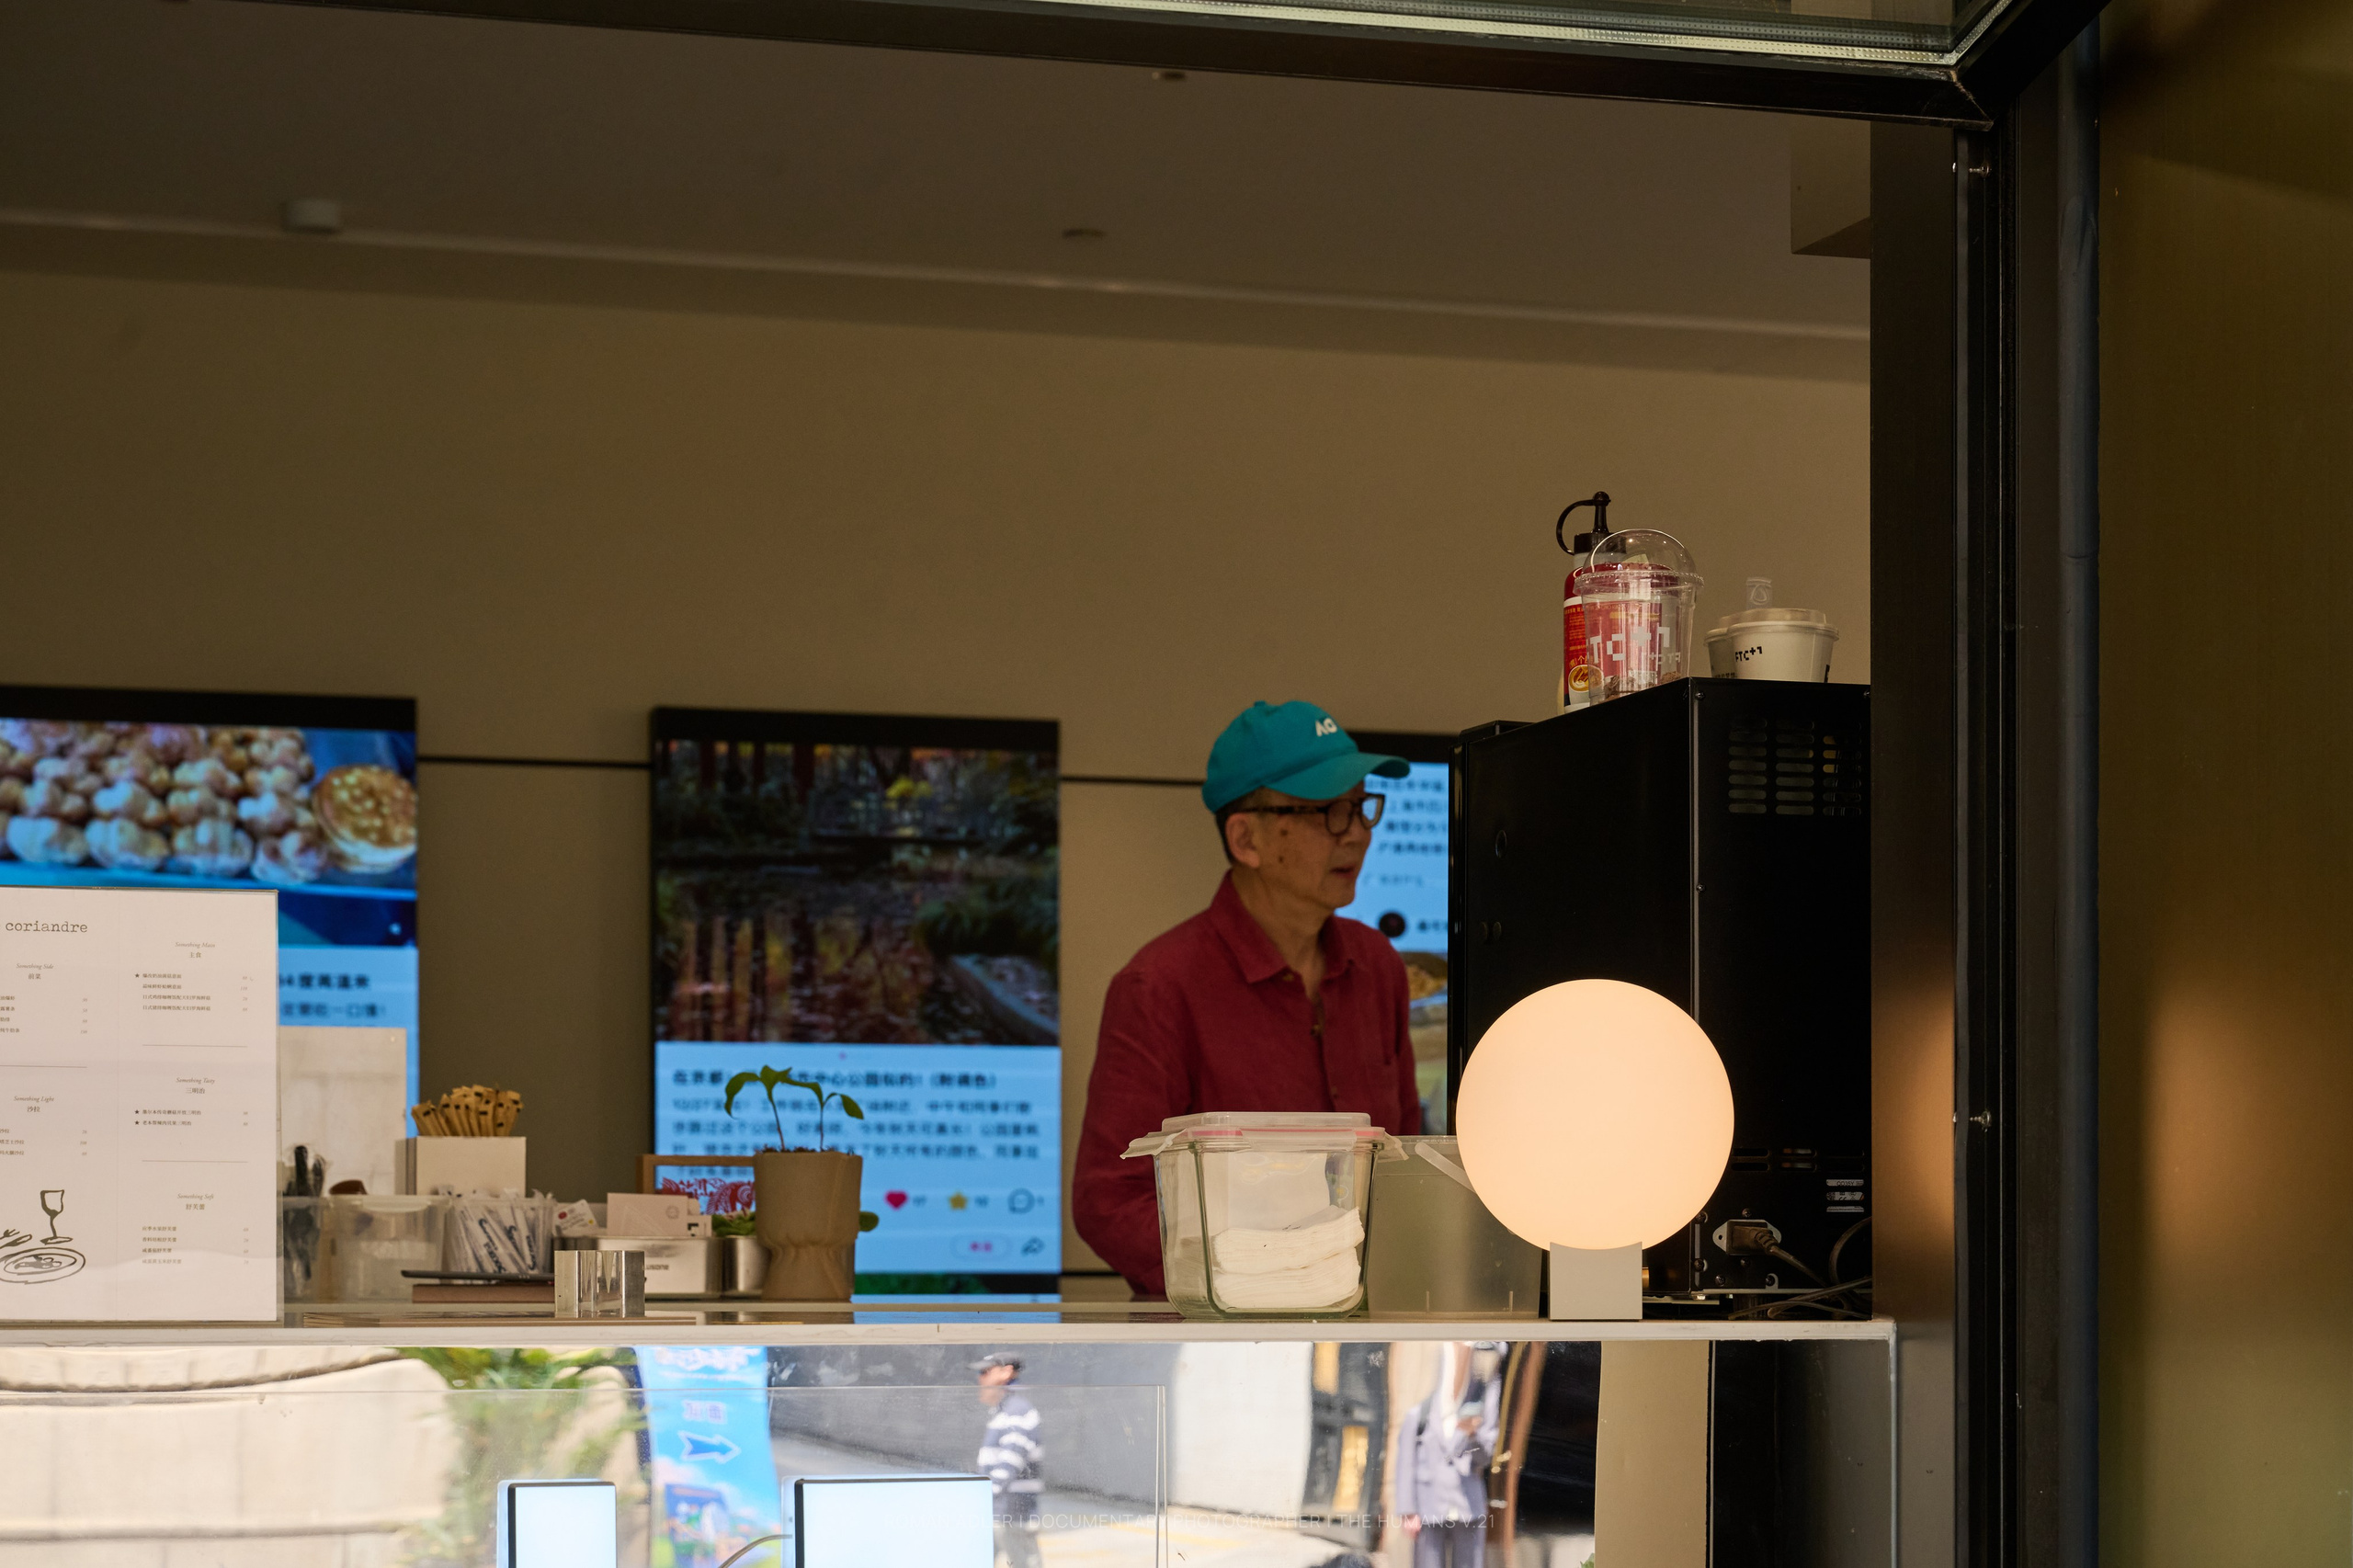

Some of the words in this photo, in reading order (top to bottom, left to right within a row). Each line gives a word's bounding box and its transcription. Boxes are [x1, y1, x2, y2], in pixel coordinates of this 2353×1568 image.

[6, 920, 88, 933] coriandre
[175, 941, 200, 949] Something
[16, 962, 42, 971] Something
